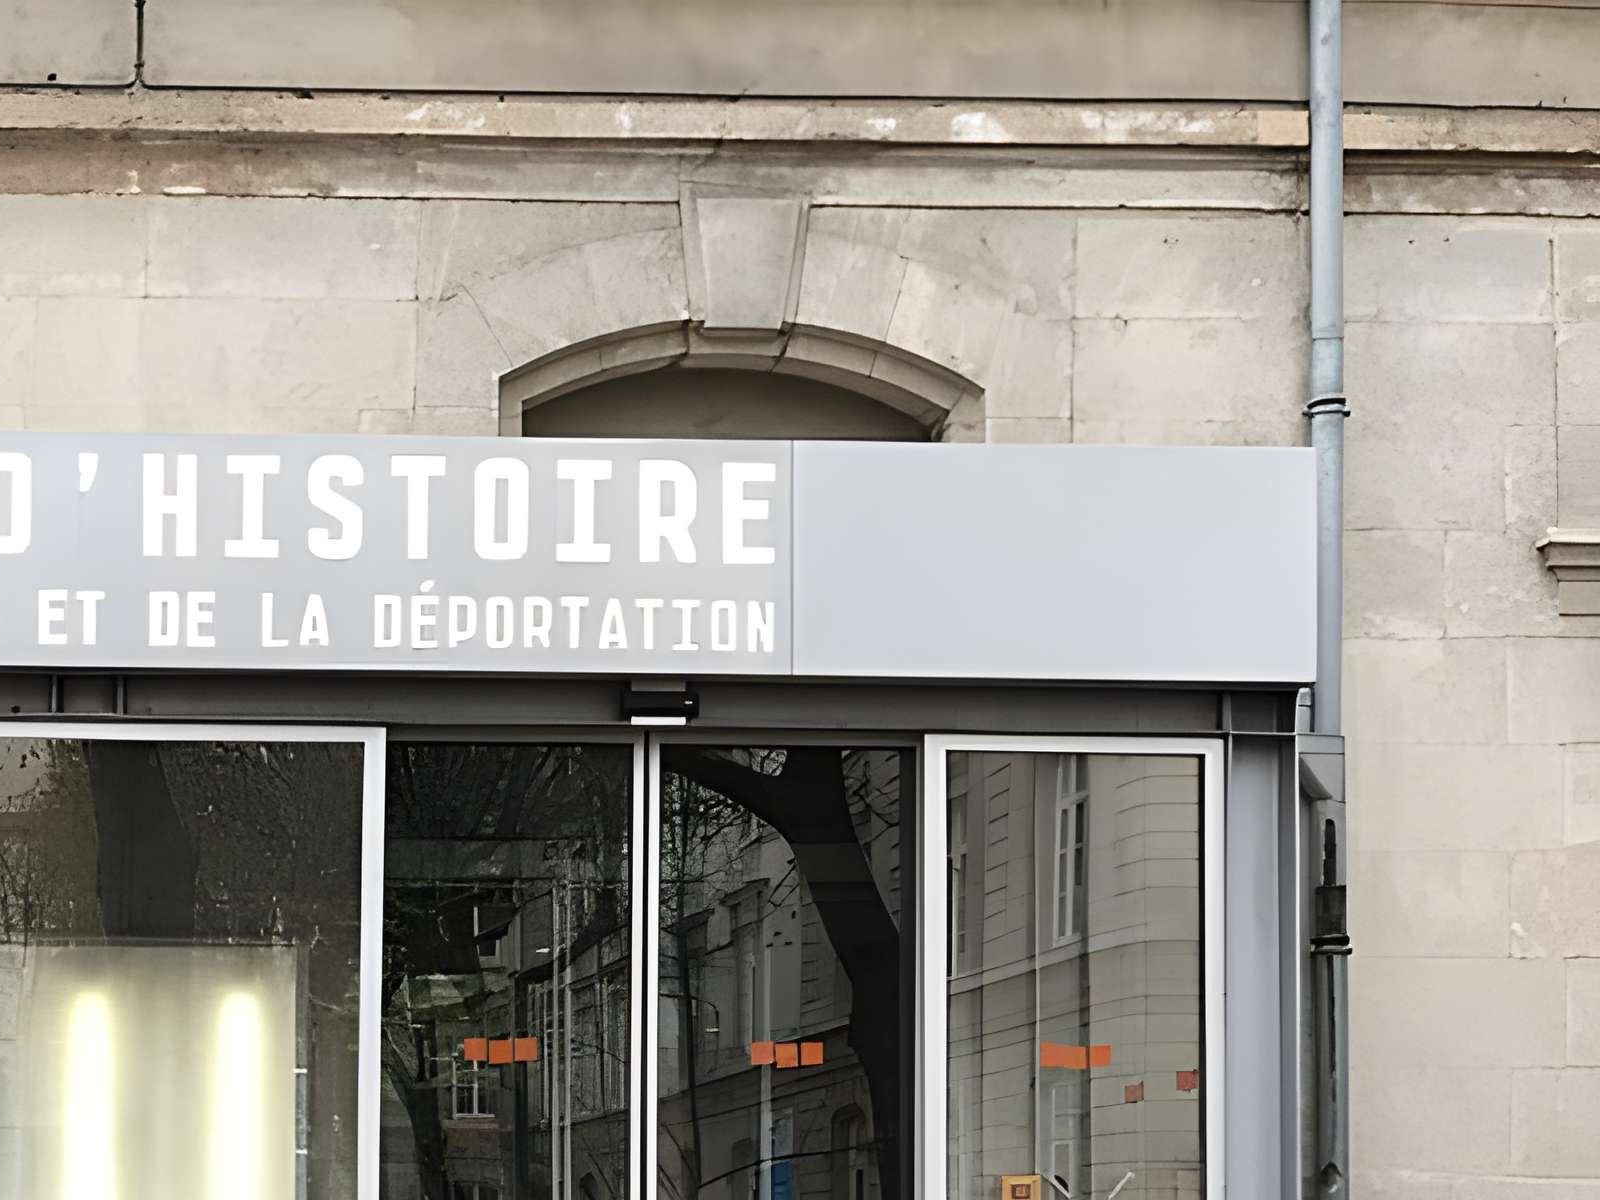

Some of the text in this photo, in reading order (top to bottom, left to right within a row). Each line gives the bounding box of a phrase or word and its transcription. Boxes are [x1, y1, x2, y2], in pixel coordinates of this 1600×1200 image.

[37, 587, 106, 645] ET
[148, 590, 217, 648] DE
[261, 592, 330, 648] LA
[373, 579, 776, 653] DÉPORTATION
